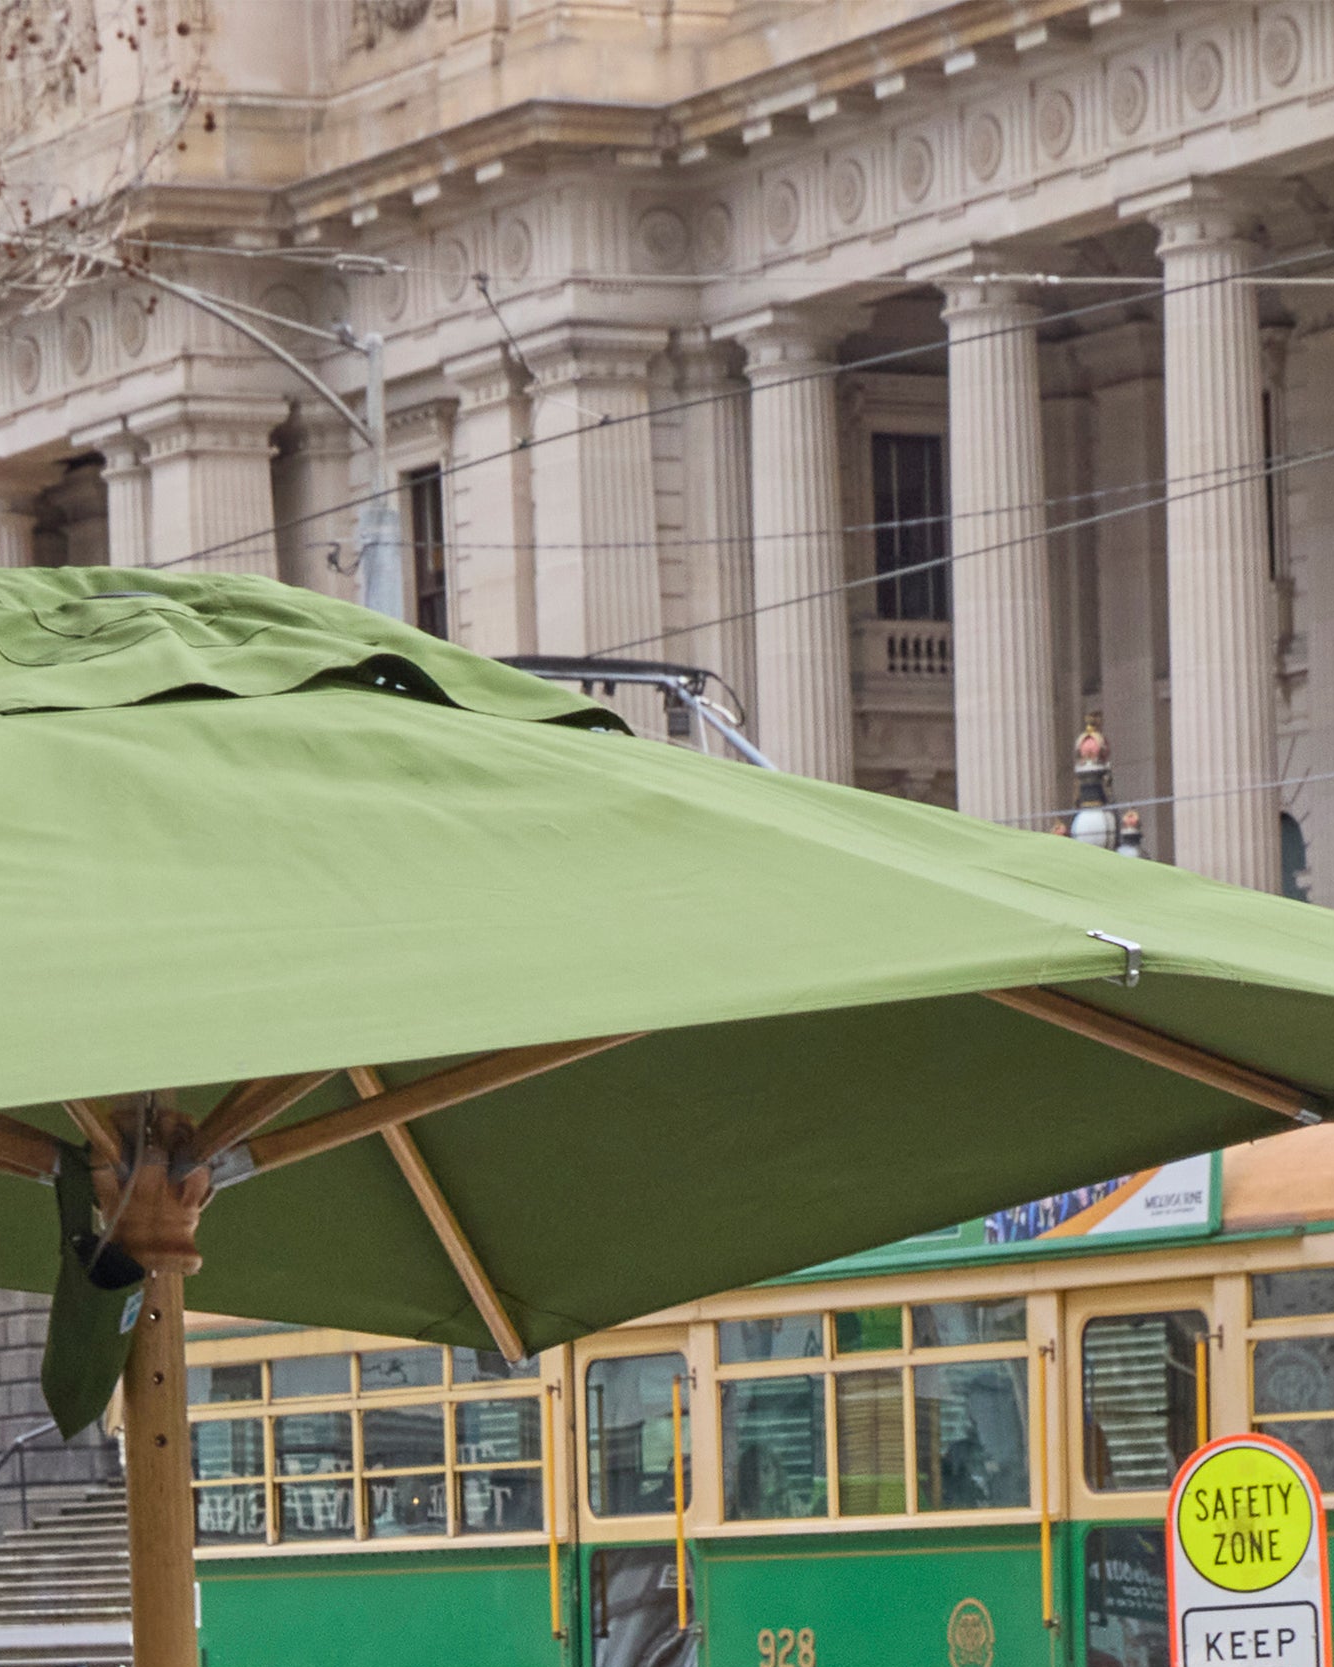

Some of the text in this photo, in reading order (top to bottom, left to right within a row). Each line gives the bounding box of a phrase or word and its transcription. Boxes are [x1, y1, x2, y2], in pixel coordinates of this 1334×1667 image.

[1194, 1482, 1294, 1523] SAFETY
[1213, 1529, 1283, 1567] ZONE
[1205, 1627, 1297, 1663] KEEP
